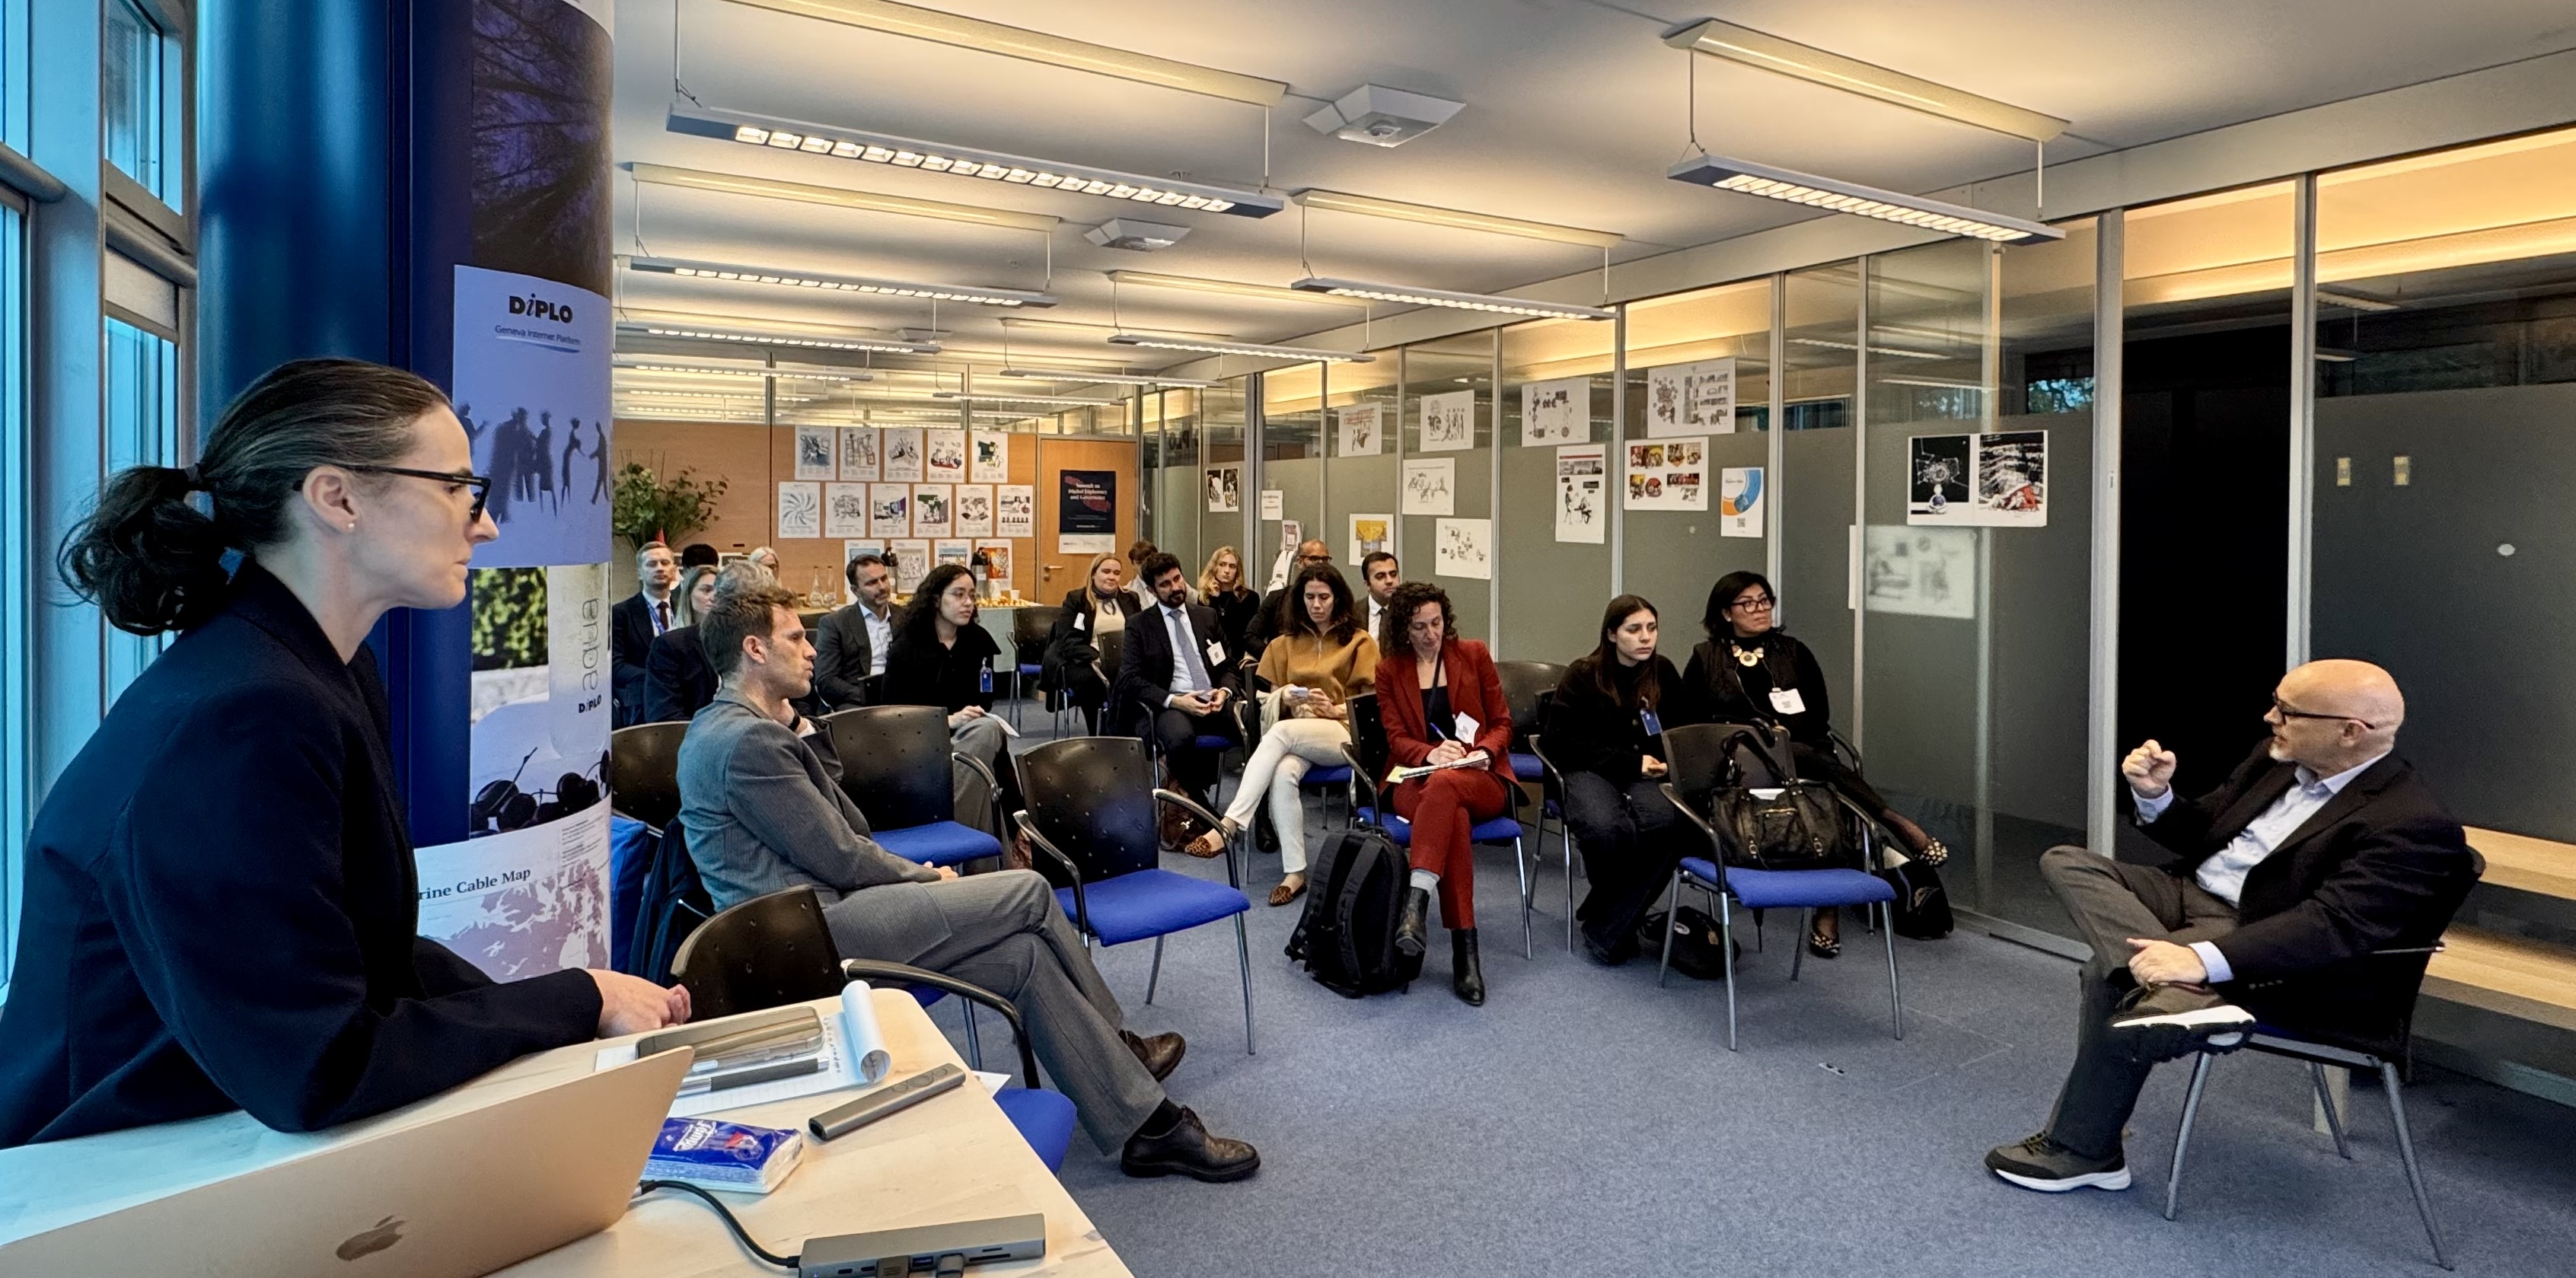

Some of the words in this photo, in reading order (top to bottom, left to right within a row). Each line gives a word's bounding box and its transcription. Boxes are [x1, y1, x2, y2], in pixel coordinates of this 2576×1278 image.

[509, 293, 572, 323] DiPLO
[495, 325, 526, 336] Geneva
[528, 328, 555, 340] Internet
[556, 334, 580, 345] Platform
[419, 887, 452, 900] rine
[457, 876, 498, 894] Cable
[502, 869, 531, 884] Map
